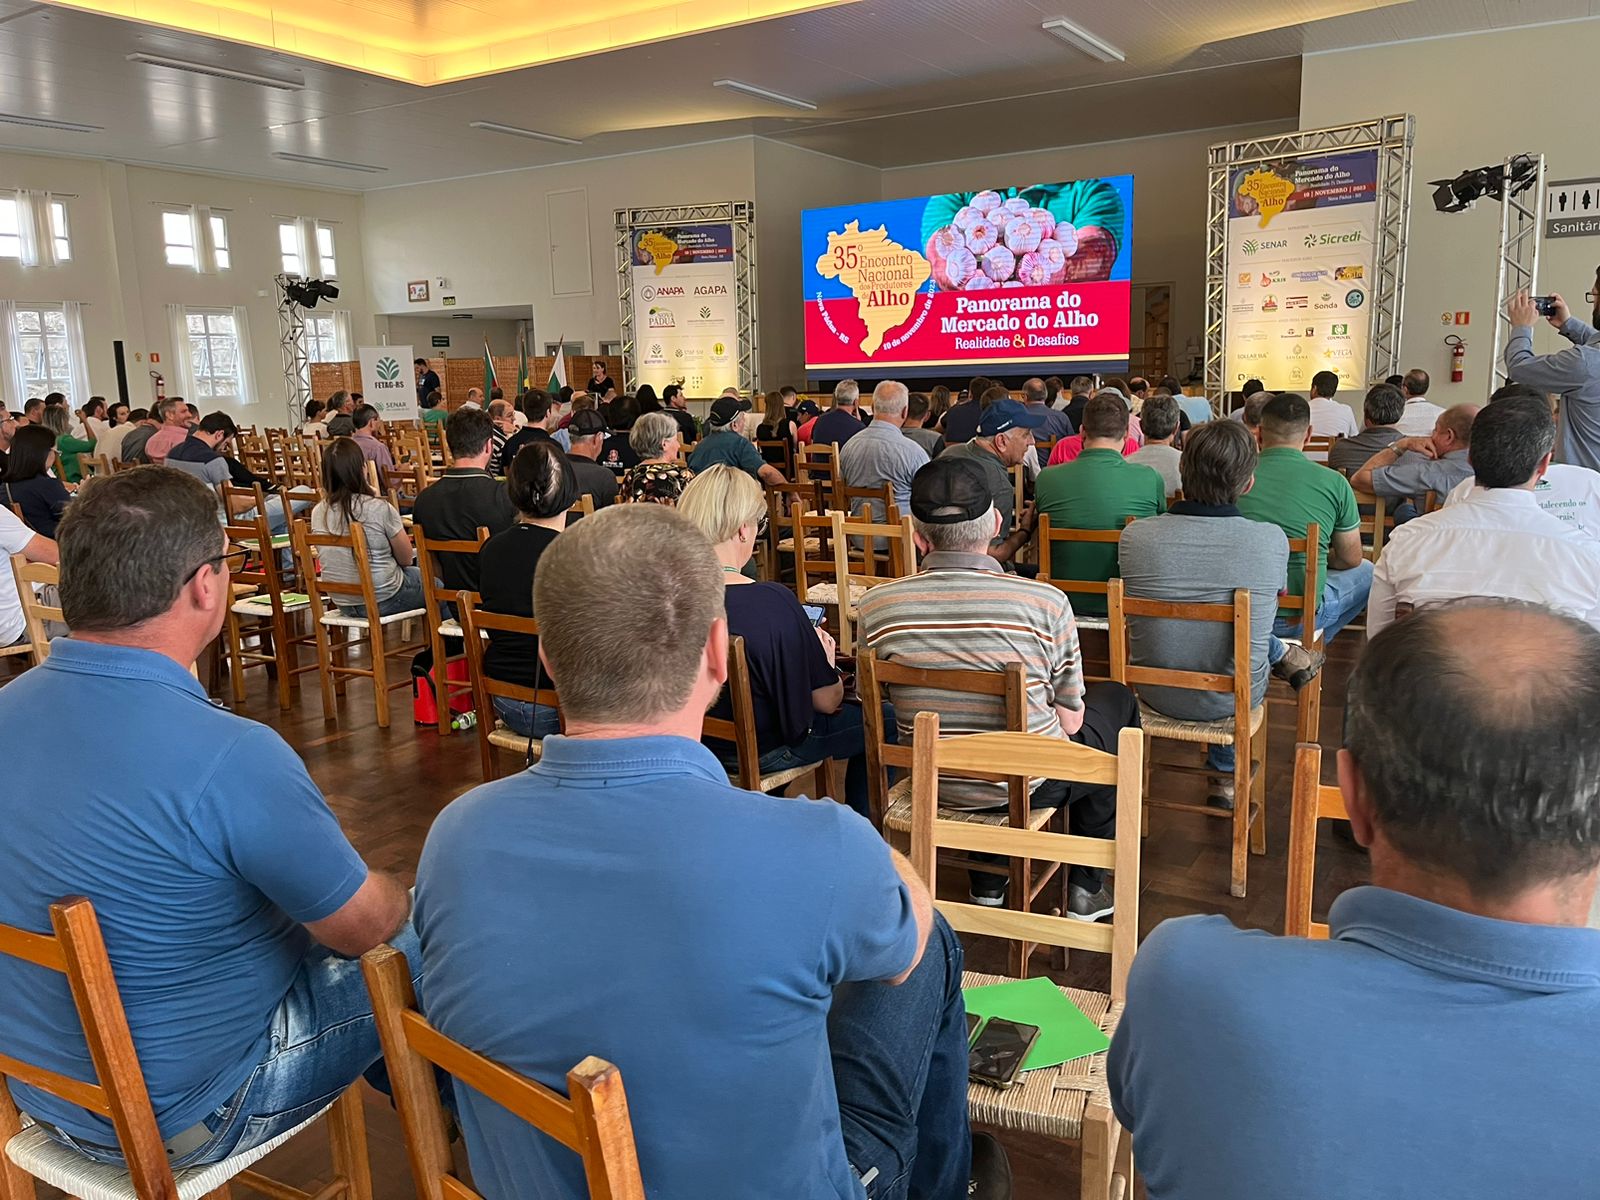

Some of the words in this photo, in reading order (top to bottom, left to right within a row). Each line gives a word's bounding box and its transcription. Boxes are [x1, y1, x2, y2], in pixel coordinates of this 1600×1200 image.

[1295, 167, 1328, 176] Panorama
[1295, 175, 1323, 184] Mercado
[1315, 187, 1348, 196] NOVEMBRO
[1263, 197, 1284, 207] Alho
[1319, 231, 1361, 244] Sicredi
[1260, 240, 1287, 249] SENAR
[860, 254, 913, 268] Encontro
[858, 266, 914, 282] Nacional
[656, 286, 685, 295] ANAPA
[694, 285, 728, 295] AGAPA
[871, 281, 913, 290] Produtores
[927, 279, 936, 299] 2023
[867, 290, 909, 307] Alho
[956, 295, 1051, 314] Panorama
[1056, 291, 1081, 308] do
[924, 299, 933, 310] de
[816, 291, 825, 312] Nova
[839, 333, 849, 344] RS
[940, 314, 1020, 333] Mercado
[1024, 312, 1048, 329] do
[1053, 310, 1099, 328] Alho
[900, 310, 928, 342] novembro
[883, 342, 892, 350] 10
[891, 338, 901, 347] de
[955, 336, 1011, 349] Realidade
[1012, 334, 1026, 348] &
[1028, 333, 1079, 347] Desafios
[375, 381, 405, 389] FETAG-RS
[1539, 499, 1577, 509] talecendo
